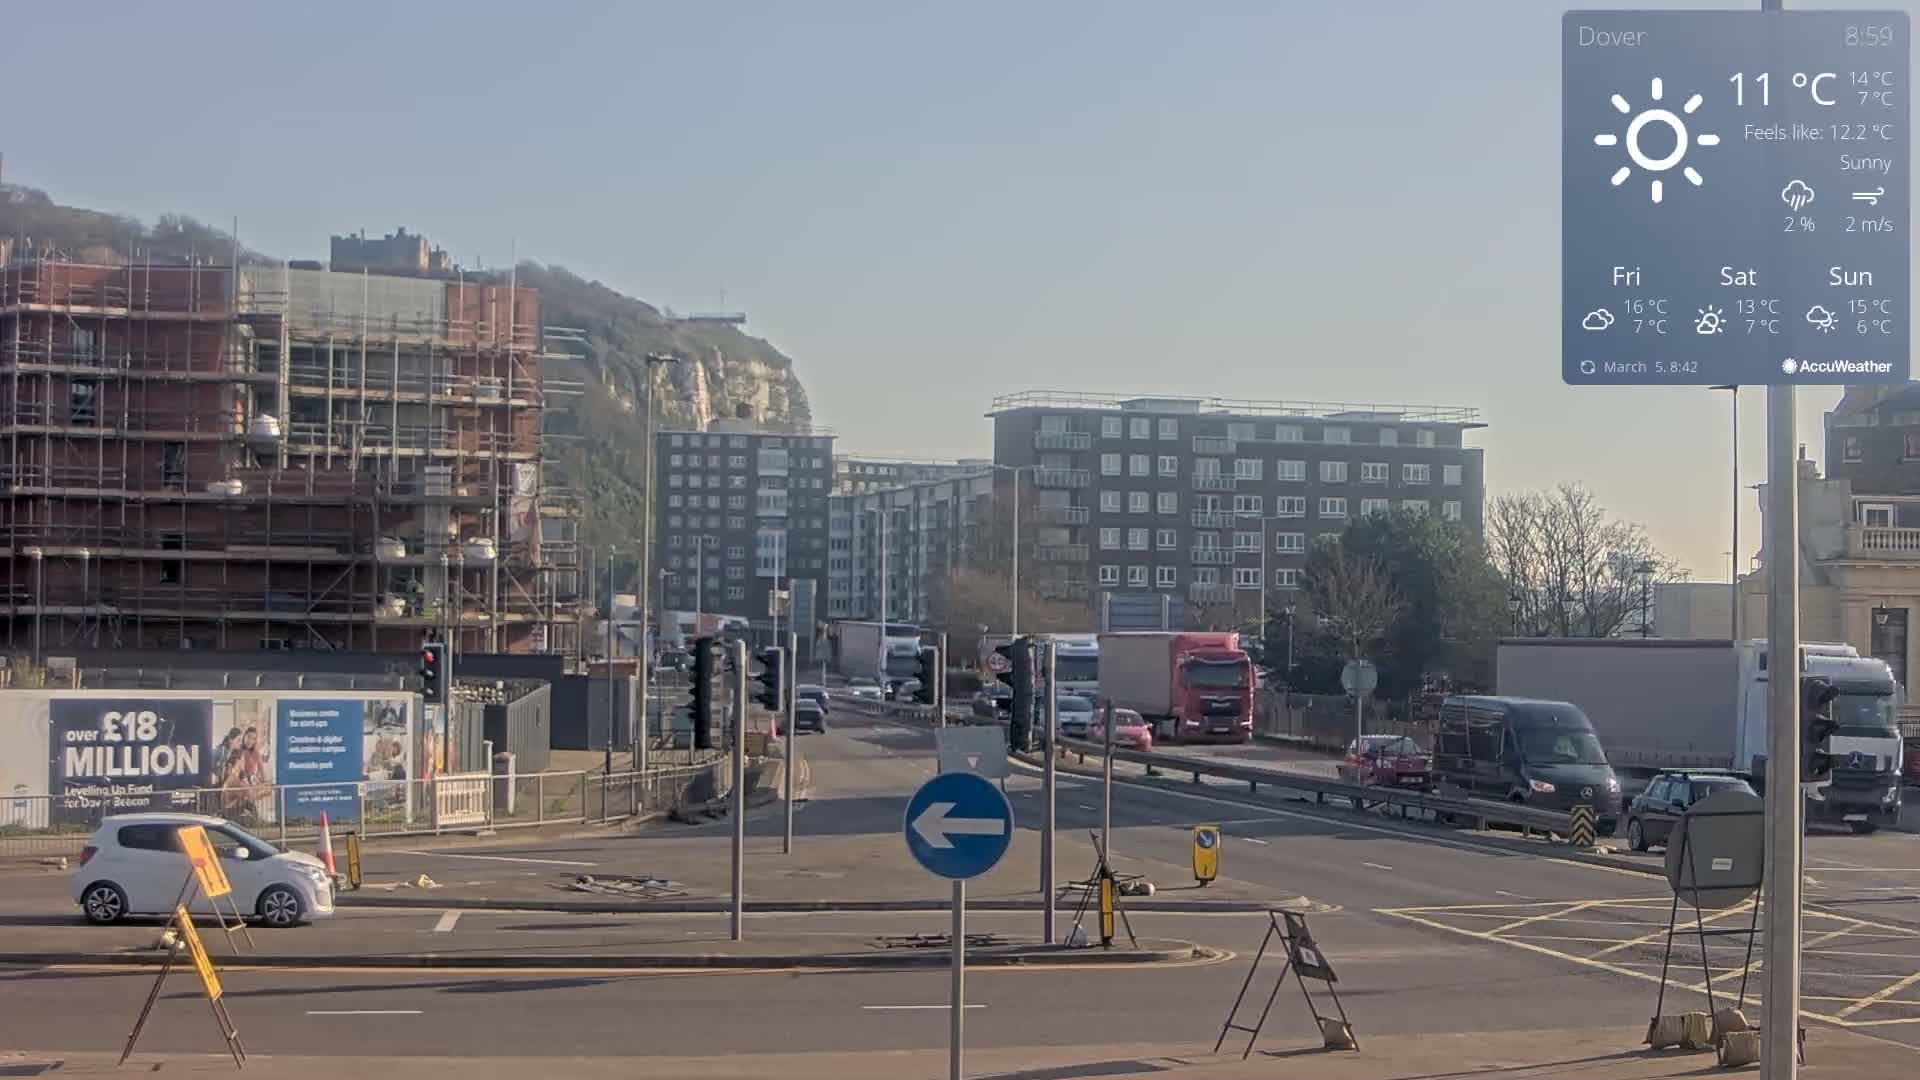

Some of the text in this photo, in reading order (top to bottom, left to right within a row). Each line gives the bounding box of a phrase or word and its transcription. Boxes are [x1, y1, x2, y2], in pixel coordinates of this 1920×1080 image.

[66, 711, 158, 742] over £18
[65, 745, 200, 777] MILLION
[65, 784, 153, 797] Levelling Up Fund
